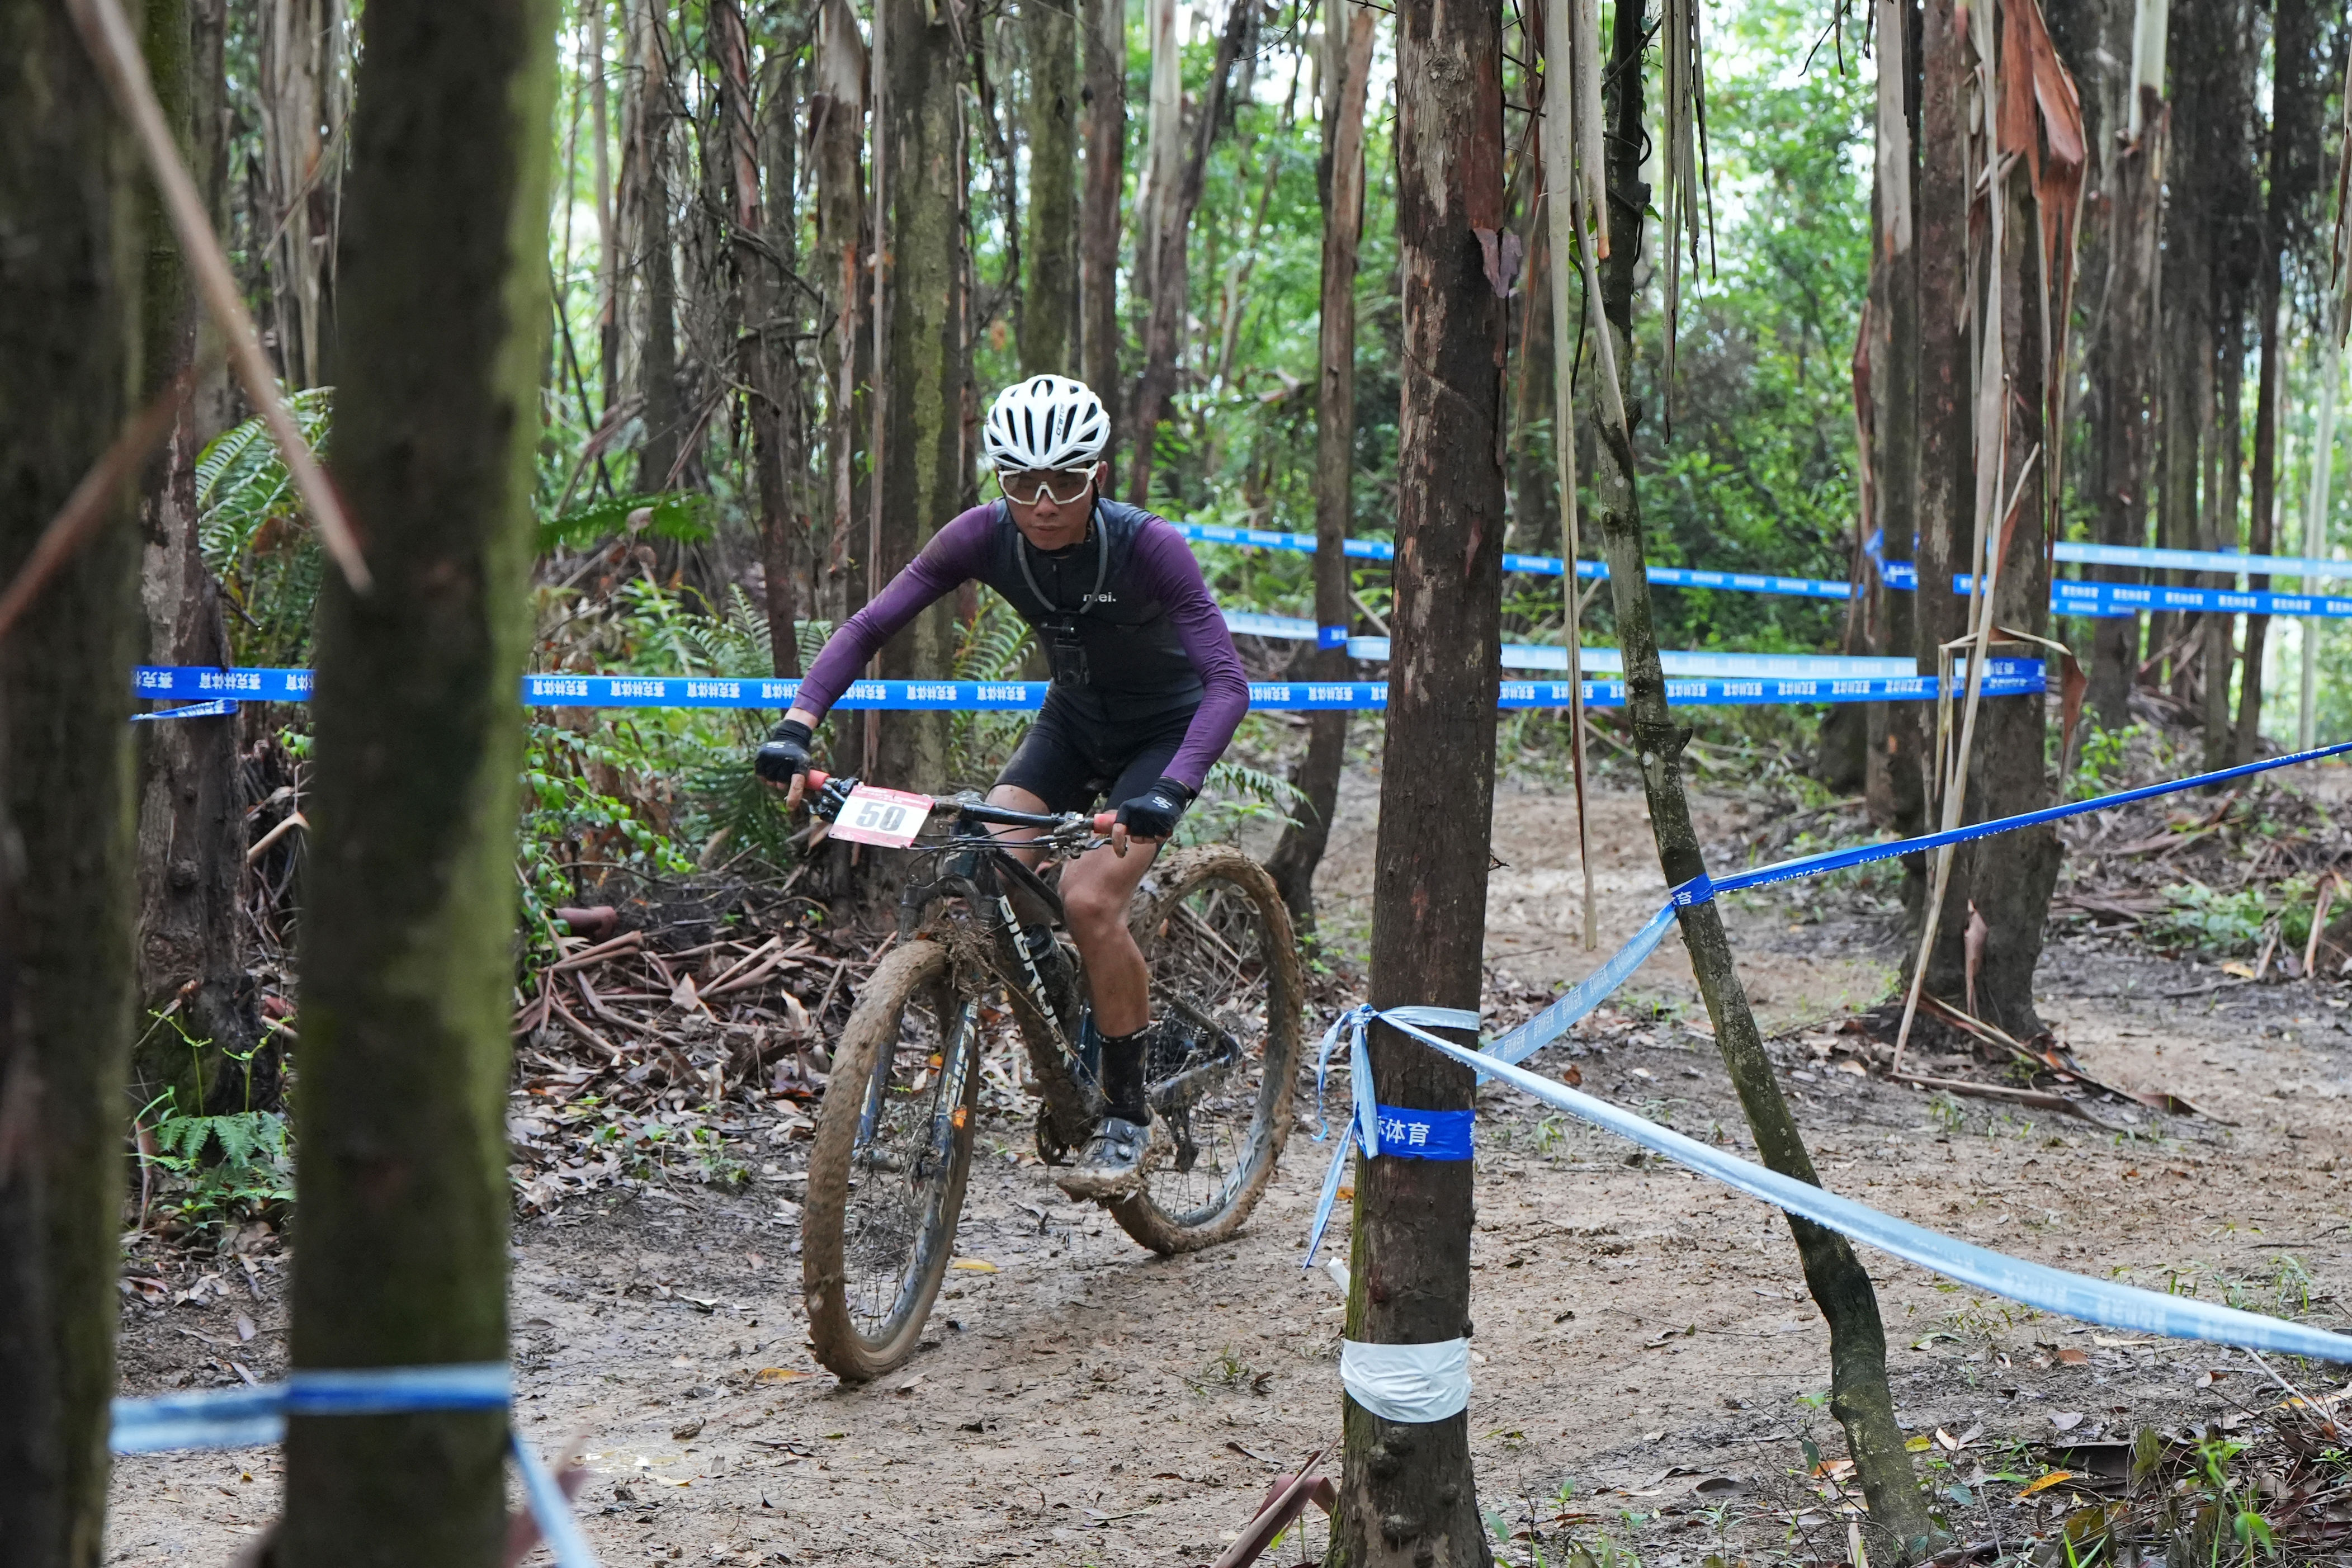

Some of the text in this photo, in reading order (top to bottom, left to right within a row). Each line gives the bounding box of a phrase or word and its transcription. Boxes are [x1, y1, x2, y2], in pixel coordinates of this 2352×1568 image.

[199, 673, 261, 691] 赛克林体育
[533, 679, 588, 697] 赛克林体育
[610, 681, 665, 698] 赛克林体育
[686, 682, 740, 698] 赛克林体育
[840, 684, 1026, 701] 赛克林体 赛克林体育 赛克林体育
[1500, 684, 1536, 700] 赛克林体
[856, 801, 907, 832] 50
